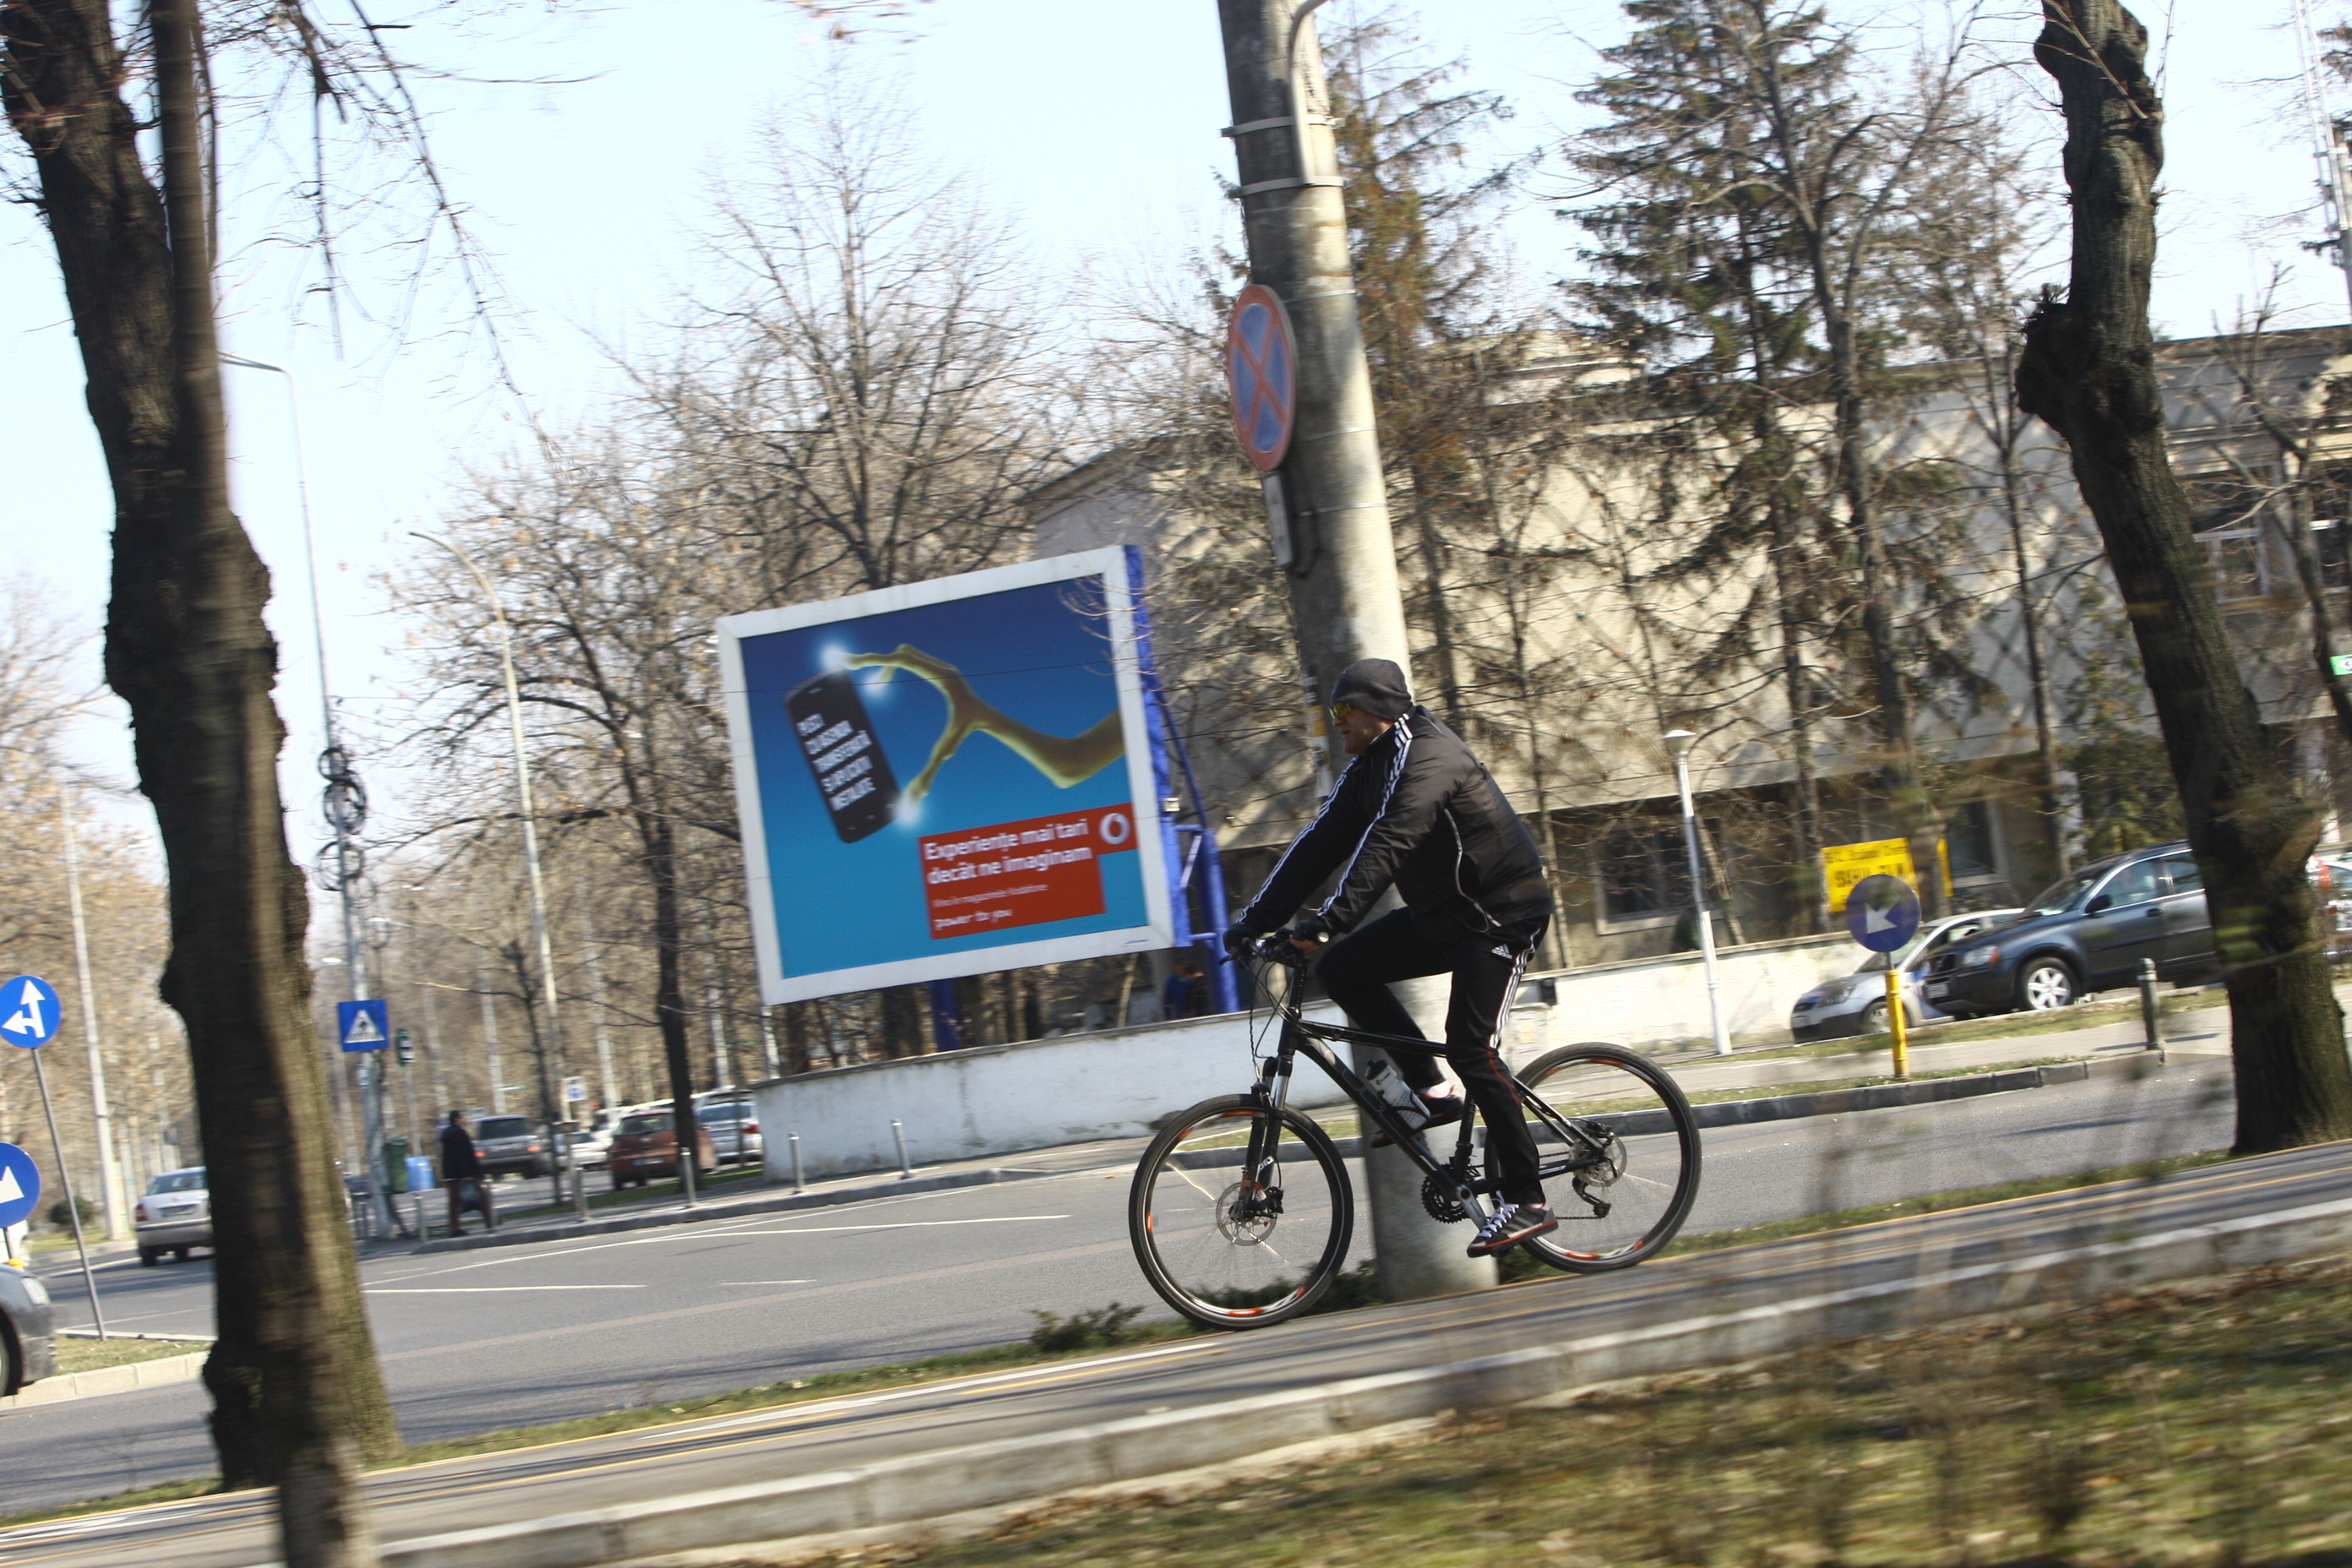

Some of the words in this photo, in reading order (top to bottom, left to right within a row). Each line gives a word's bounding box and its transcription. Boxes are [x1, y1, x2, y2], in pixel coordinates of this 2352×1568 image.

[1019, 823, 1055, 845] mai
[1056, 819, 1089, 838] tari
[927, 862, 977, 885] decât
[978, 861, 1002, 877] ne
[1002, 847, 1093, 872] imaginam
[933, 915, 974, 931] power
[974, 911, 990, 922] to
[990, 909, 1013, 924] you
